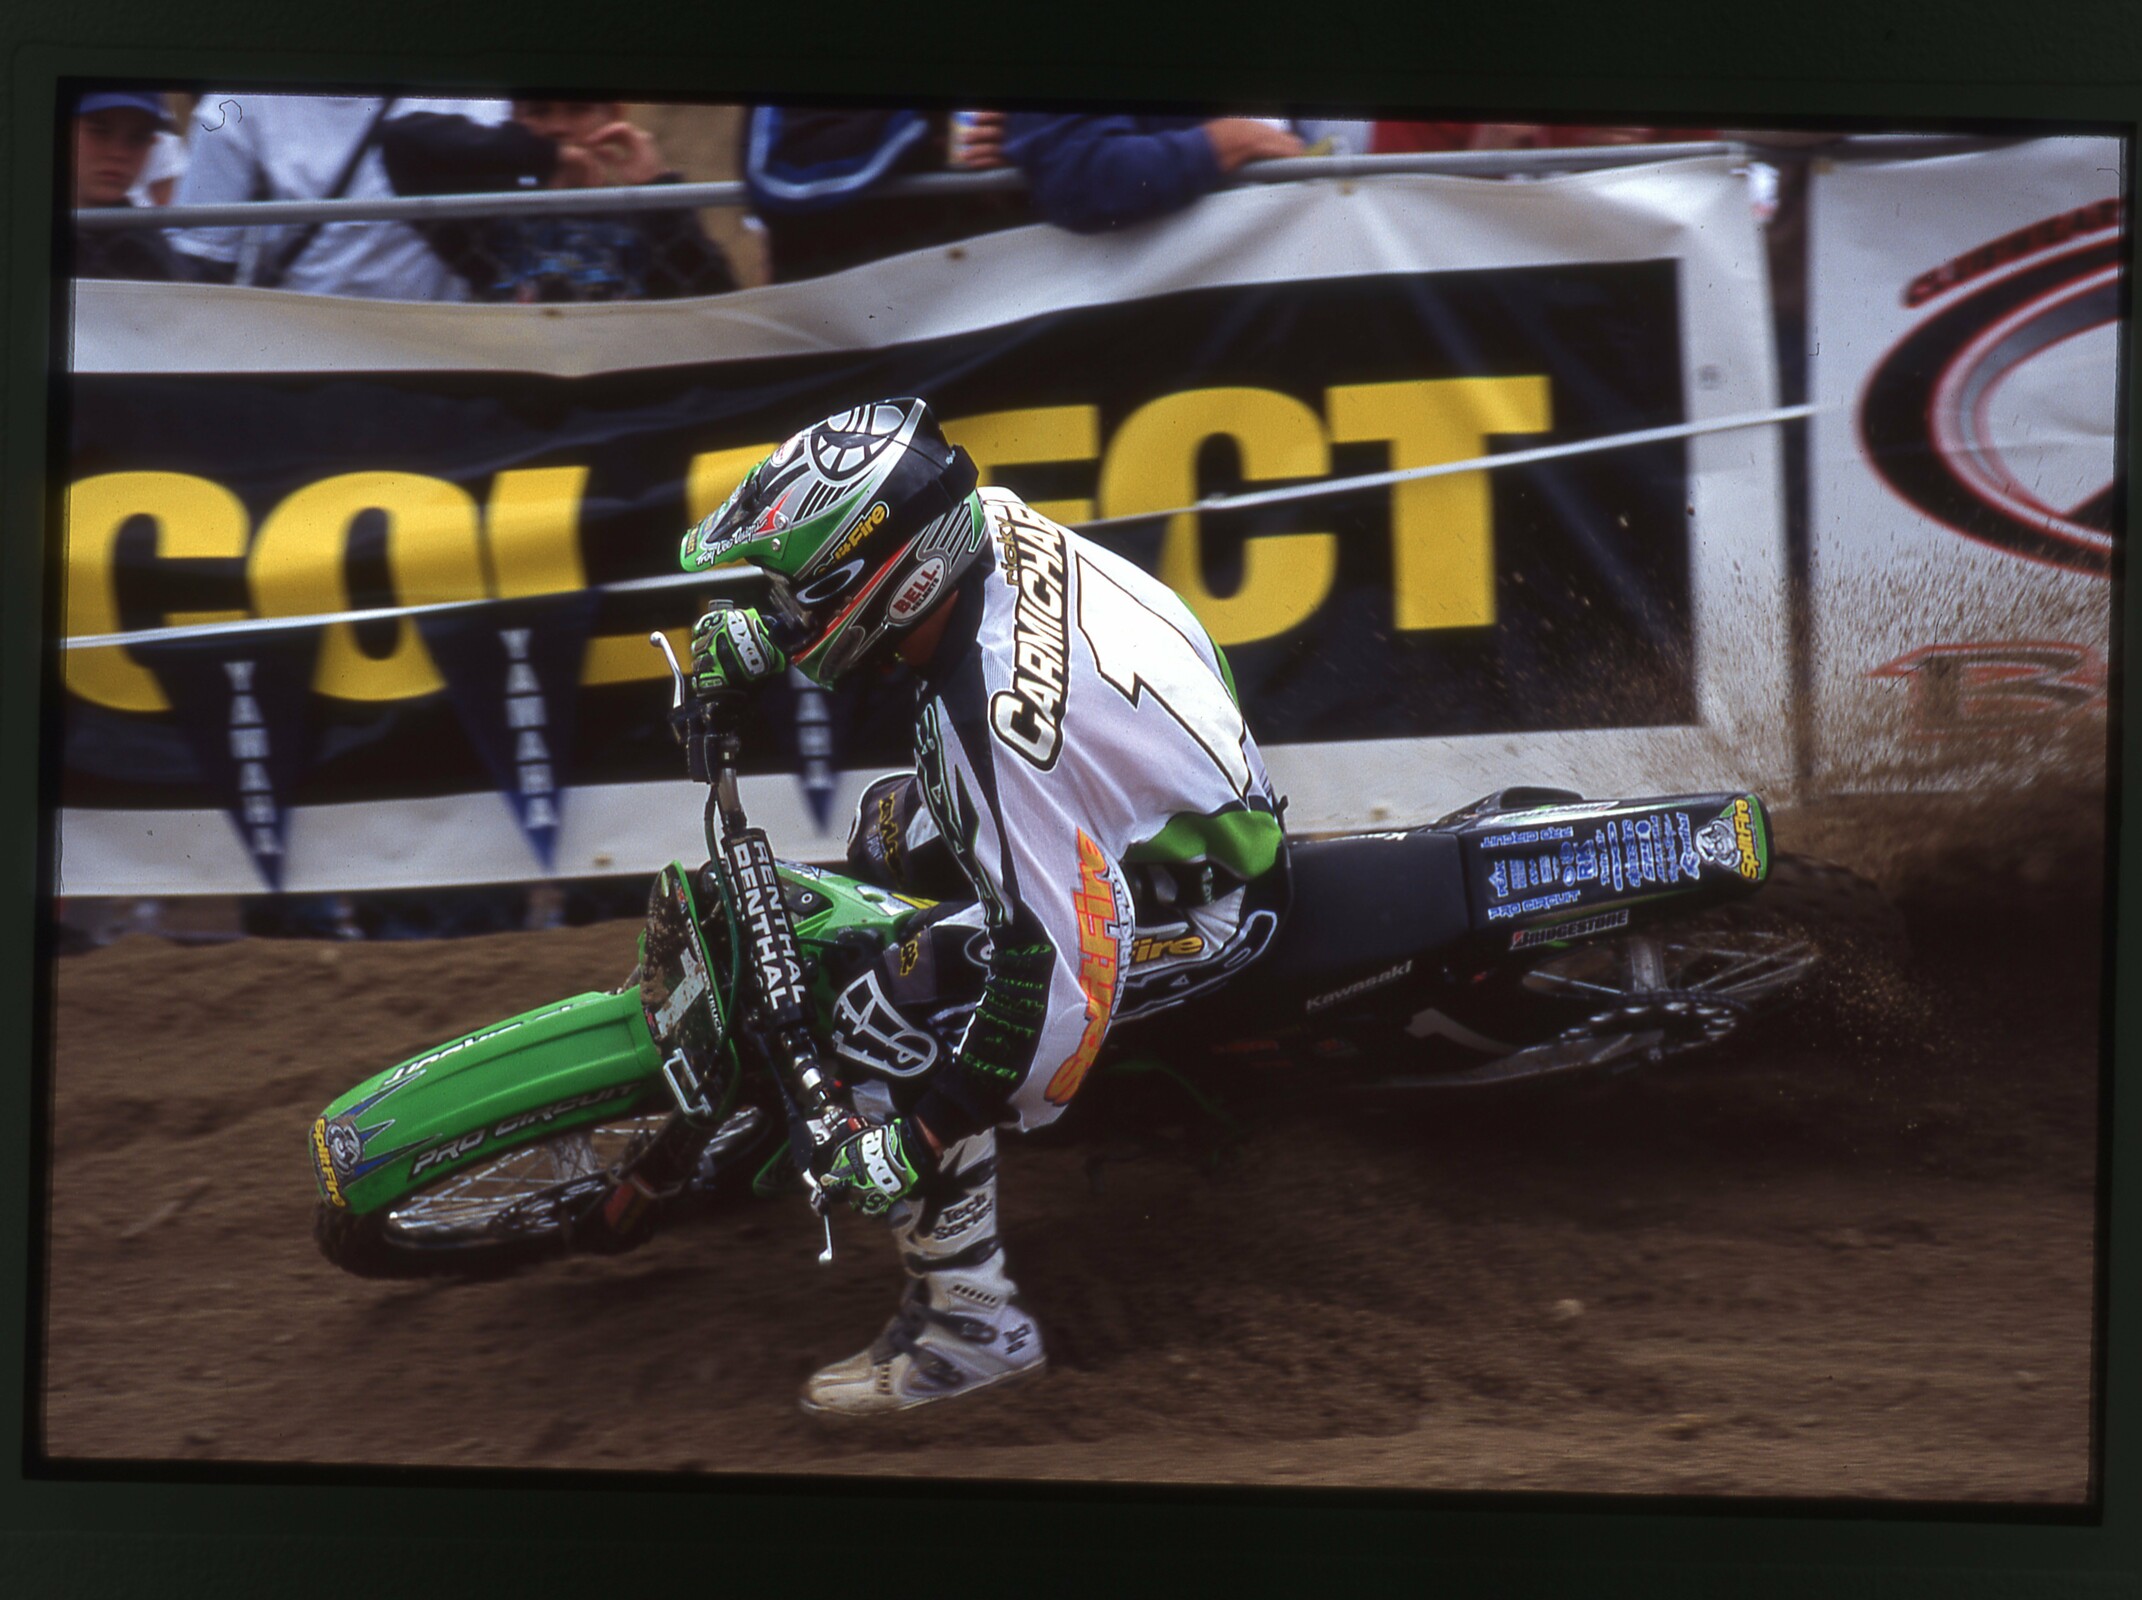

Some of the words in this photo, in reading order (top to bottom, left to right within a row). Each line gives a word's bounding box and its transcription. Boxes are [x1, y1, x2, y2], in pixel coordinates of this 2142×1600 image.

[63, 374, 1553, 712] COLCT
[997, 516, 1020, 587] ricky
[893, 565, 938, 614] BELL
[1480, 830, 1539, 849] CIRCUIT
[1540, 826, 1574, 841] PRO
[1576, 838, 1599, 882] RK
[1675, 812, 1701, 880] Renthal
[1734, 798, 1760, 880] SplitFire
[733, 843, 788, 1011] RENTHAL
[753, 840, 806, 1005] RENTHAL
[1488, 902, 1522, 920] PRO
[1521, 889, 1581, 912] CIRCUIT
[1305, 958, 1413, 1011] Kawasaki
[412, 1128, 486, 1176] PRO
[494, 1081, 642, 1138] CIRCUIT
[313, 1118, 347, 1208] SplitFire
[934, 1200, 993, 1240] Series
[943, 1194, 987, 1223] Tech
